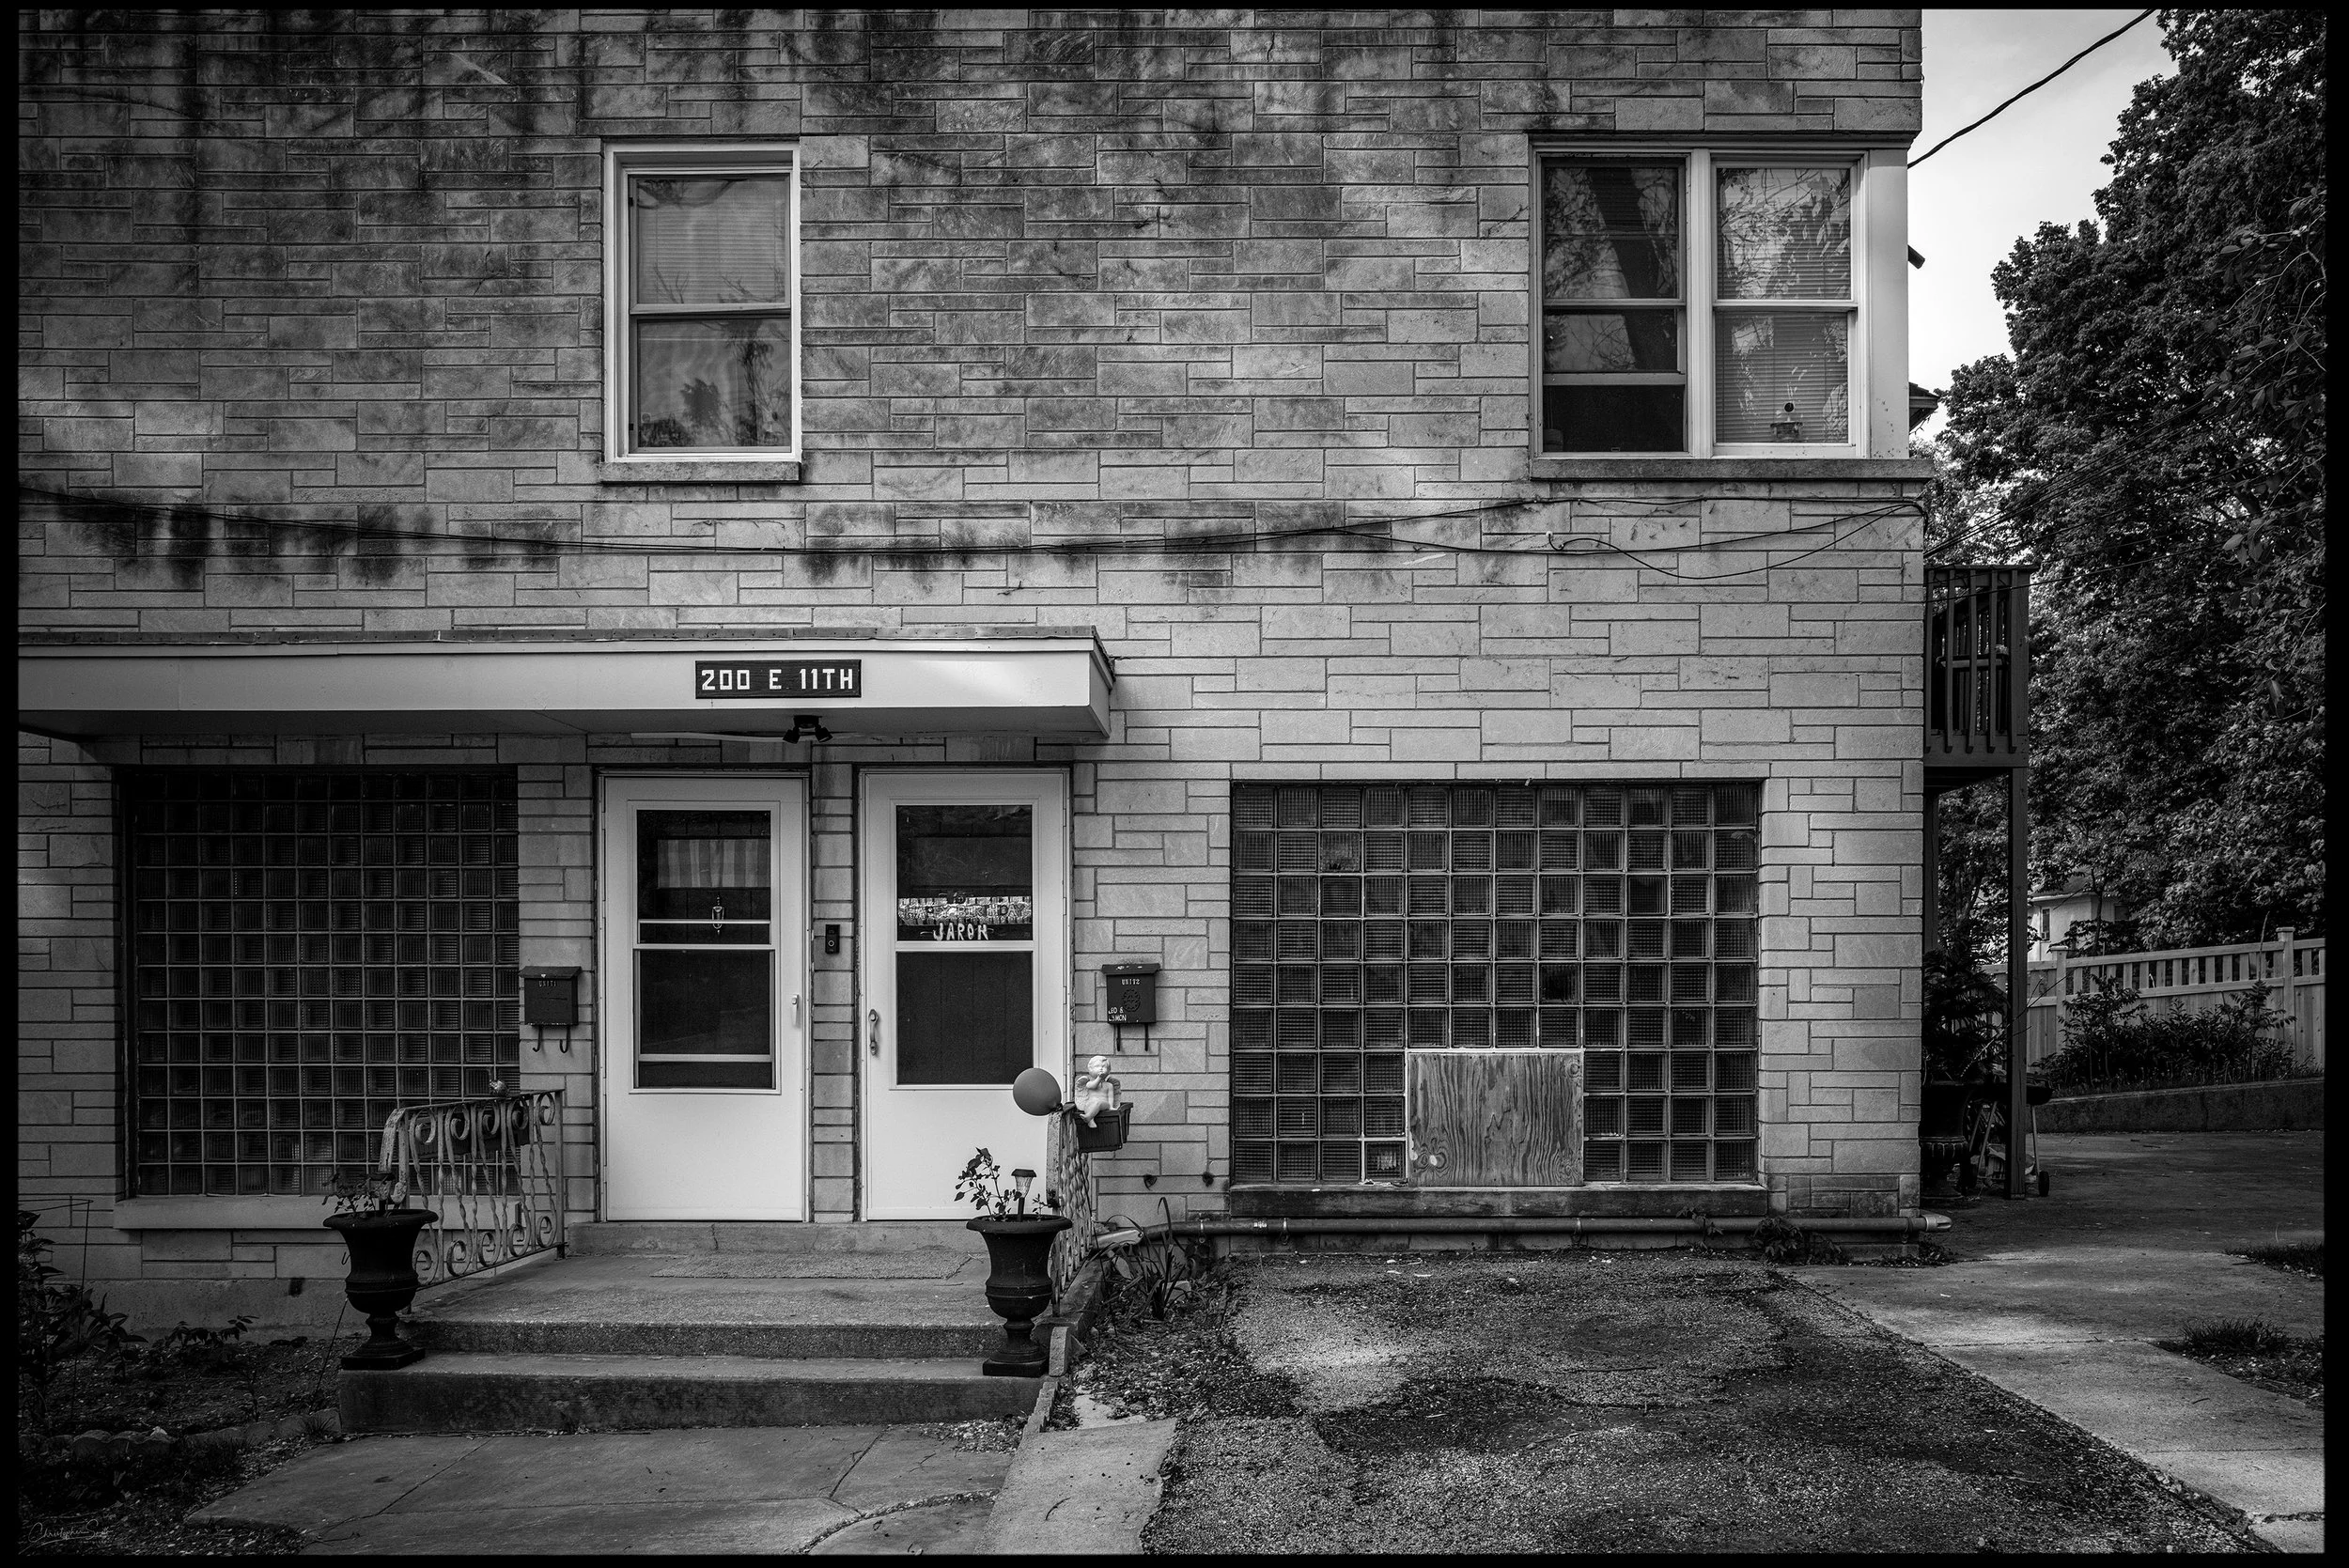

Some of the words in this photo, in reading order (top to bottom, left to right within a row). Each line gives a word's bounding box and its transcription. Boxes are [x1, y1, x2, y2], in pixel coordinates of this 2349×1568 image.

[701, 669, 751, 691] 200
[769, 669, 782, 690] E
[799, 668, 853, 690] 11TH
